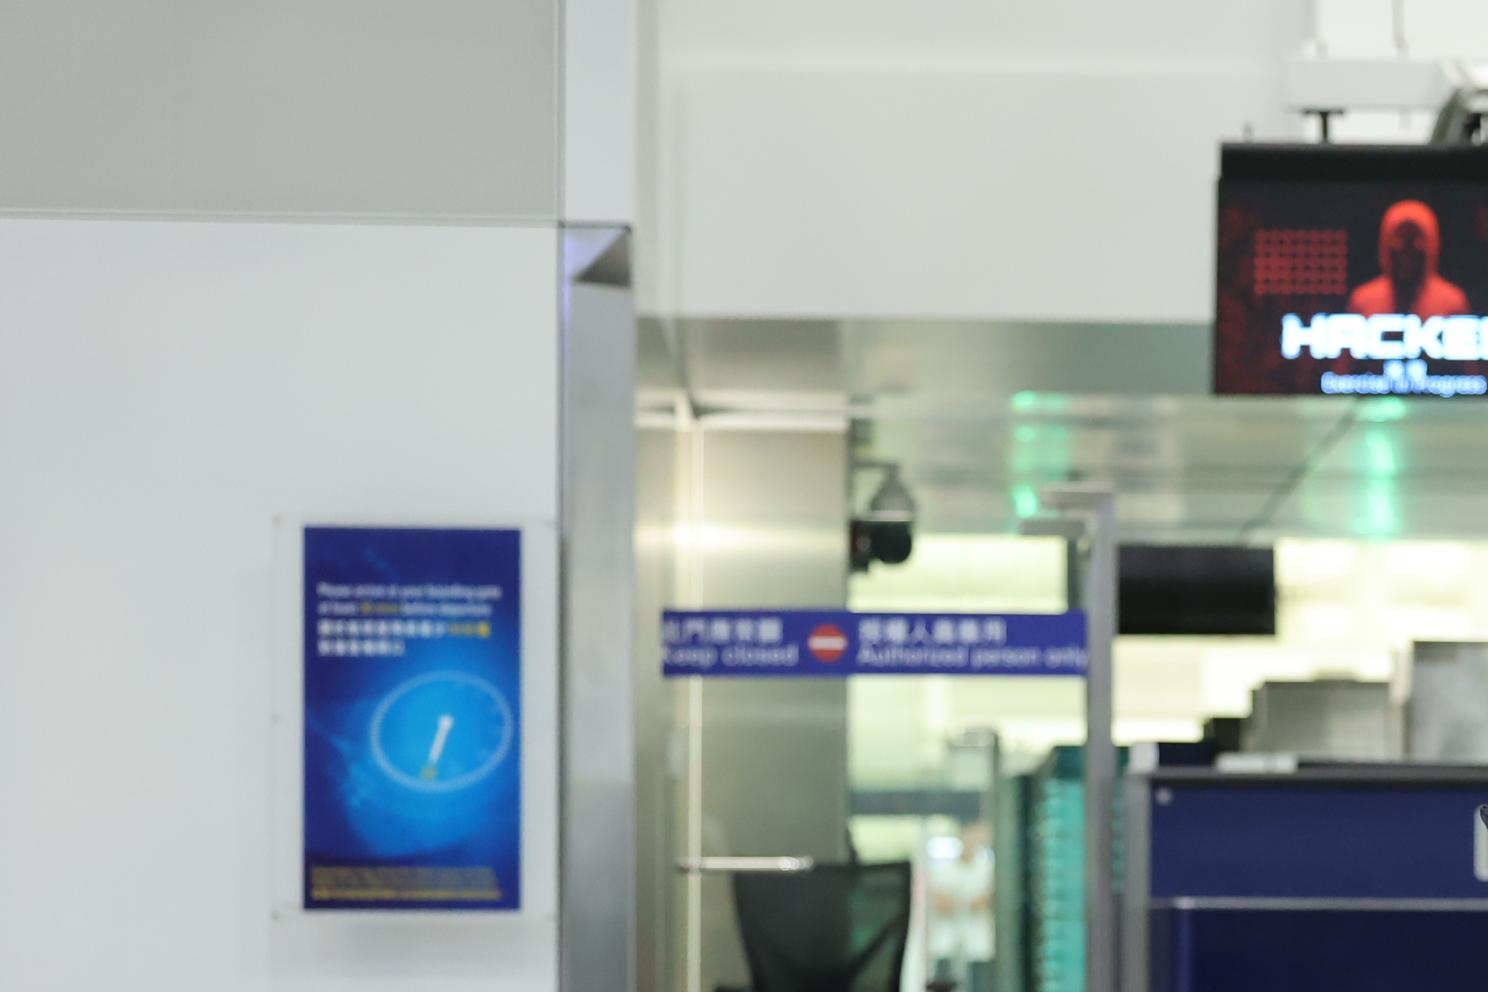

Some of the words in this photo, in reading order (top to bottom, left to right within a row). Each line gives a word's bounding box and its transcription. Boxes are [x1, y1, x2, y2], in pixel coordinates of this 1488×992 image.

[722, 643, 797, 665] closed
[858, 643, 966, 666] Authorized
[971, 647, 1040, 668] person
